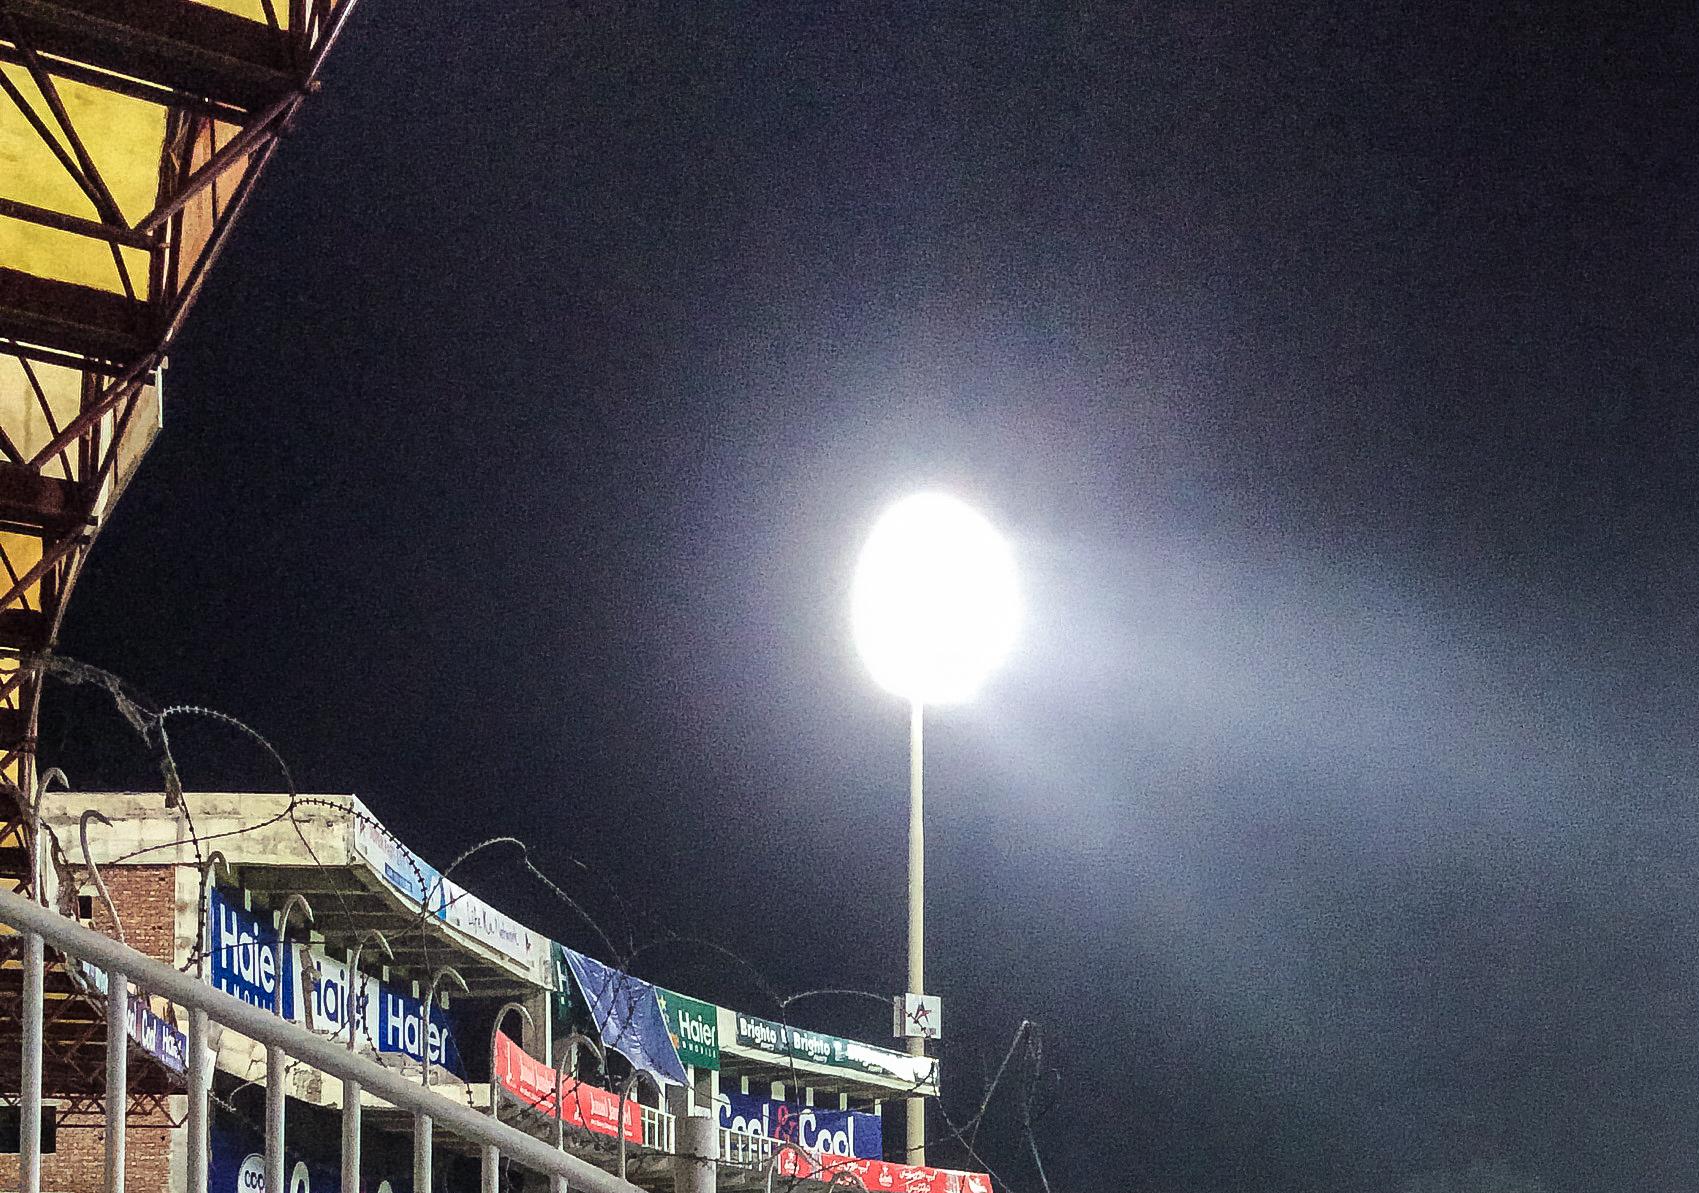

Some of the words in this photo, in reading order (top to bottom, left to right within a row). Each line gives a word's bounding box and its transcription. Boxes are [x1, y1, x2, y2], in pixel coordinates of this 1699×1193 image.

[219, 903, 276, 994] Haie
[387, 993, 450, 1064] Haier
[678, 1009, 716, 1048] Haier
[739, 1015, 777, 1045] Brighto
[793, 1030, 831, 1057] Brighto
[800, 1108, 856, 1158] Cool
